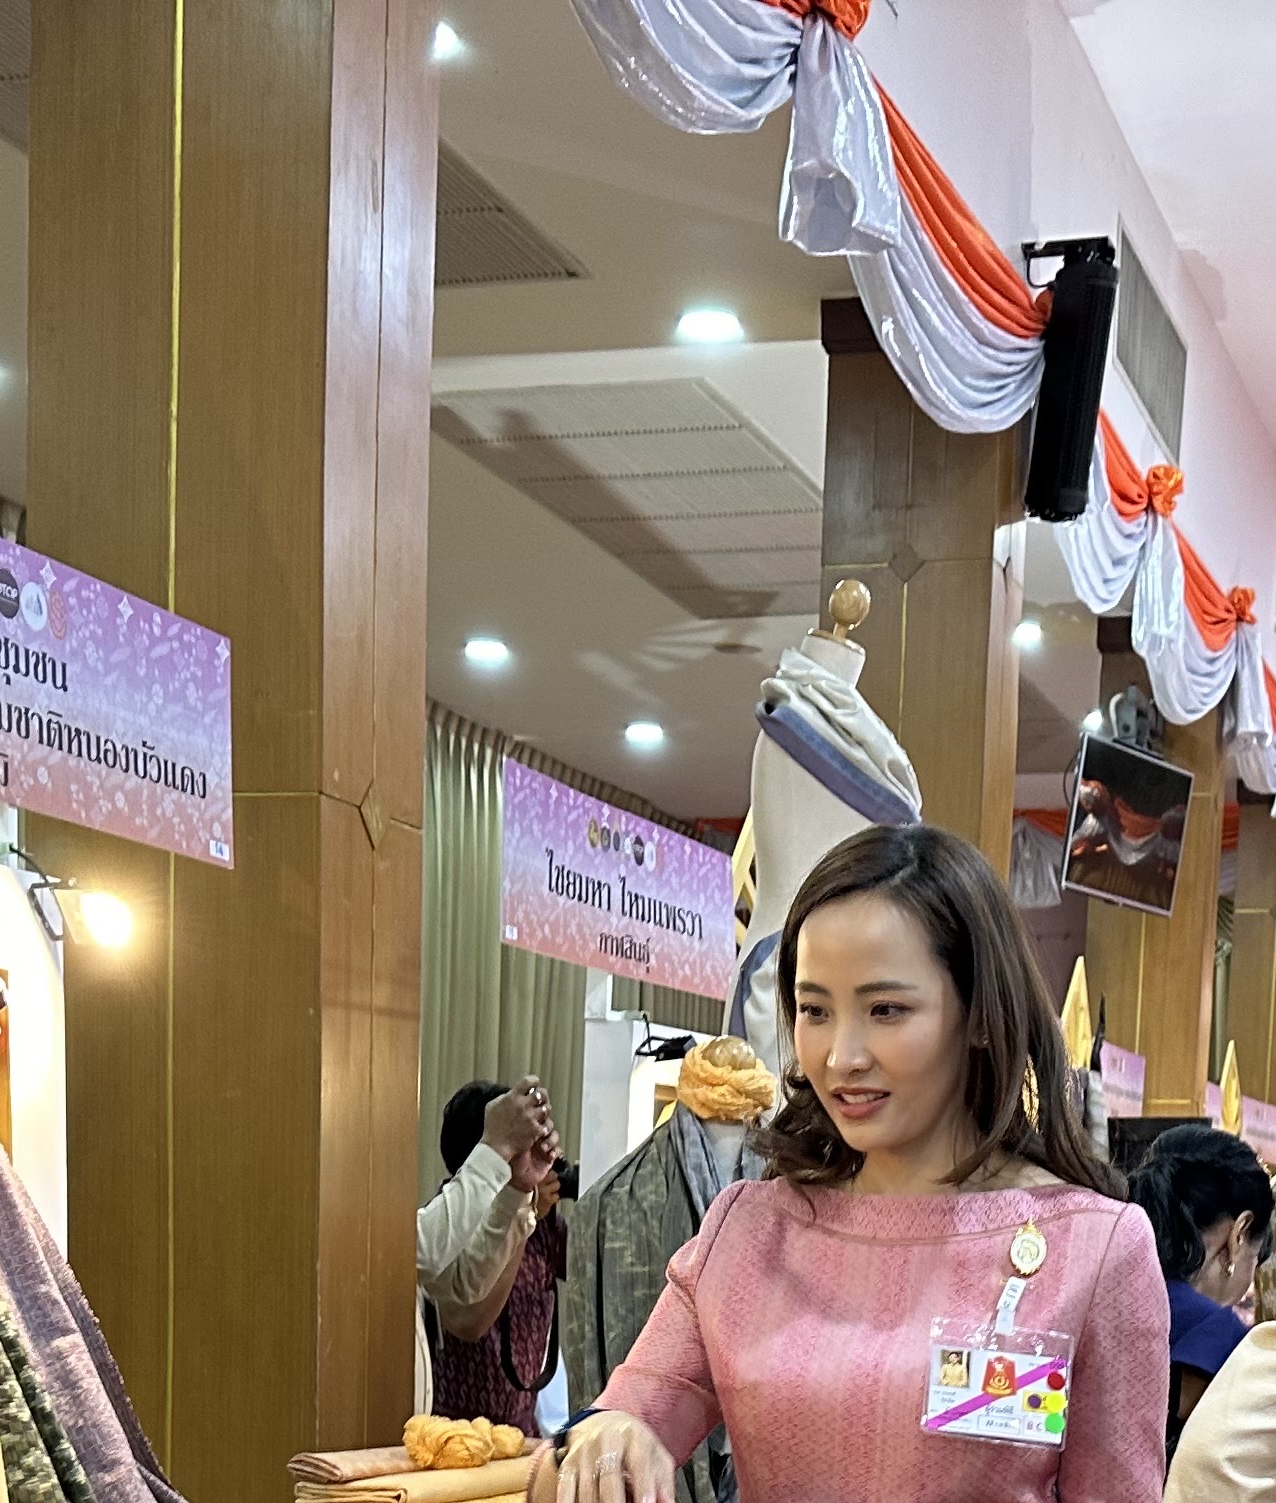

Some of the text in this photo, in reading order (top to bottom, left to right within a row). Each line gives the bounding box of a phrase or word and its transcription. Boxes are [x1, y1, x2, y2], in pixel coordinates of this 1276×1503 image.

[546, 847, 704, 941] ไชยมหา ไหมแพรวา
